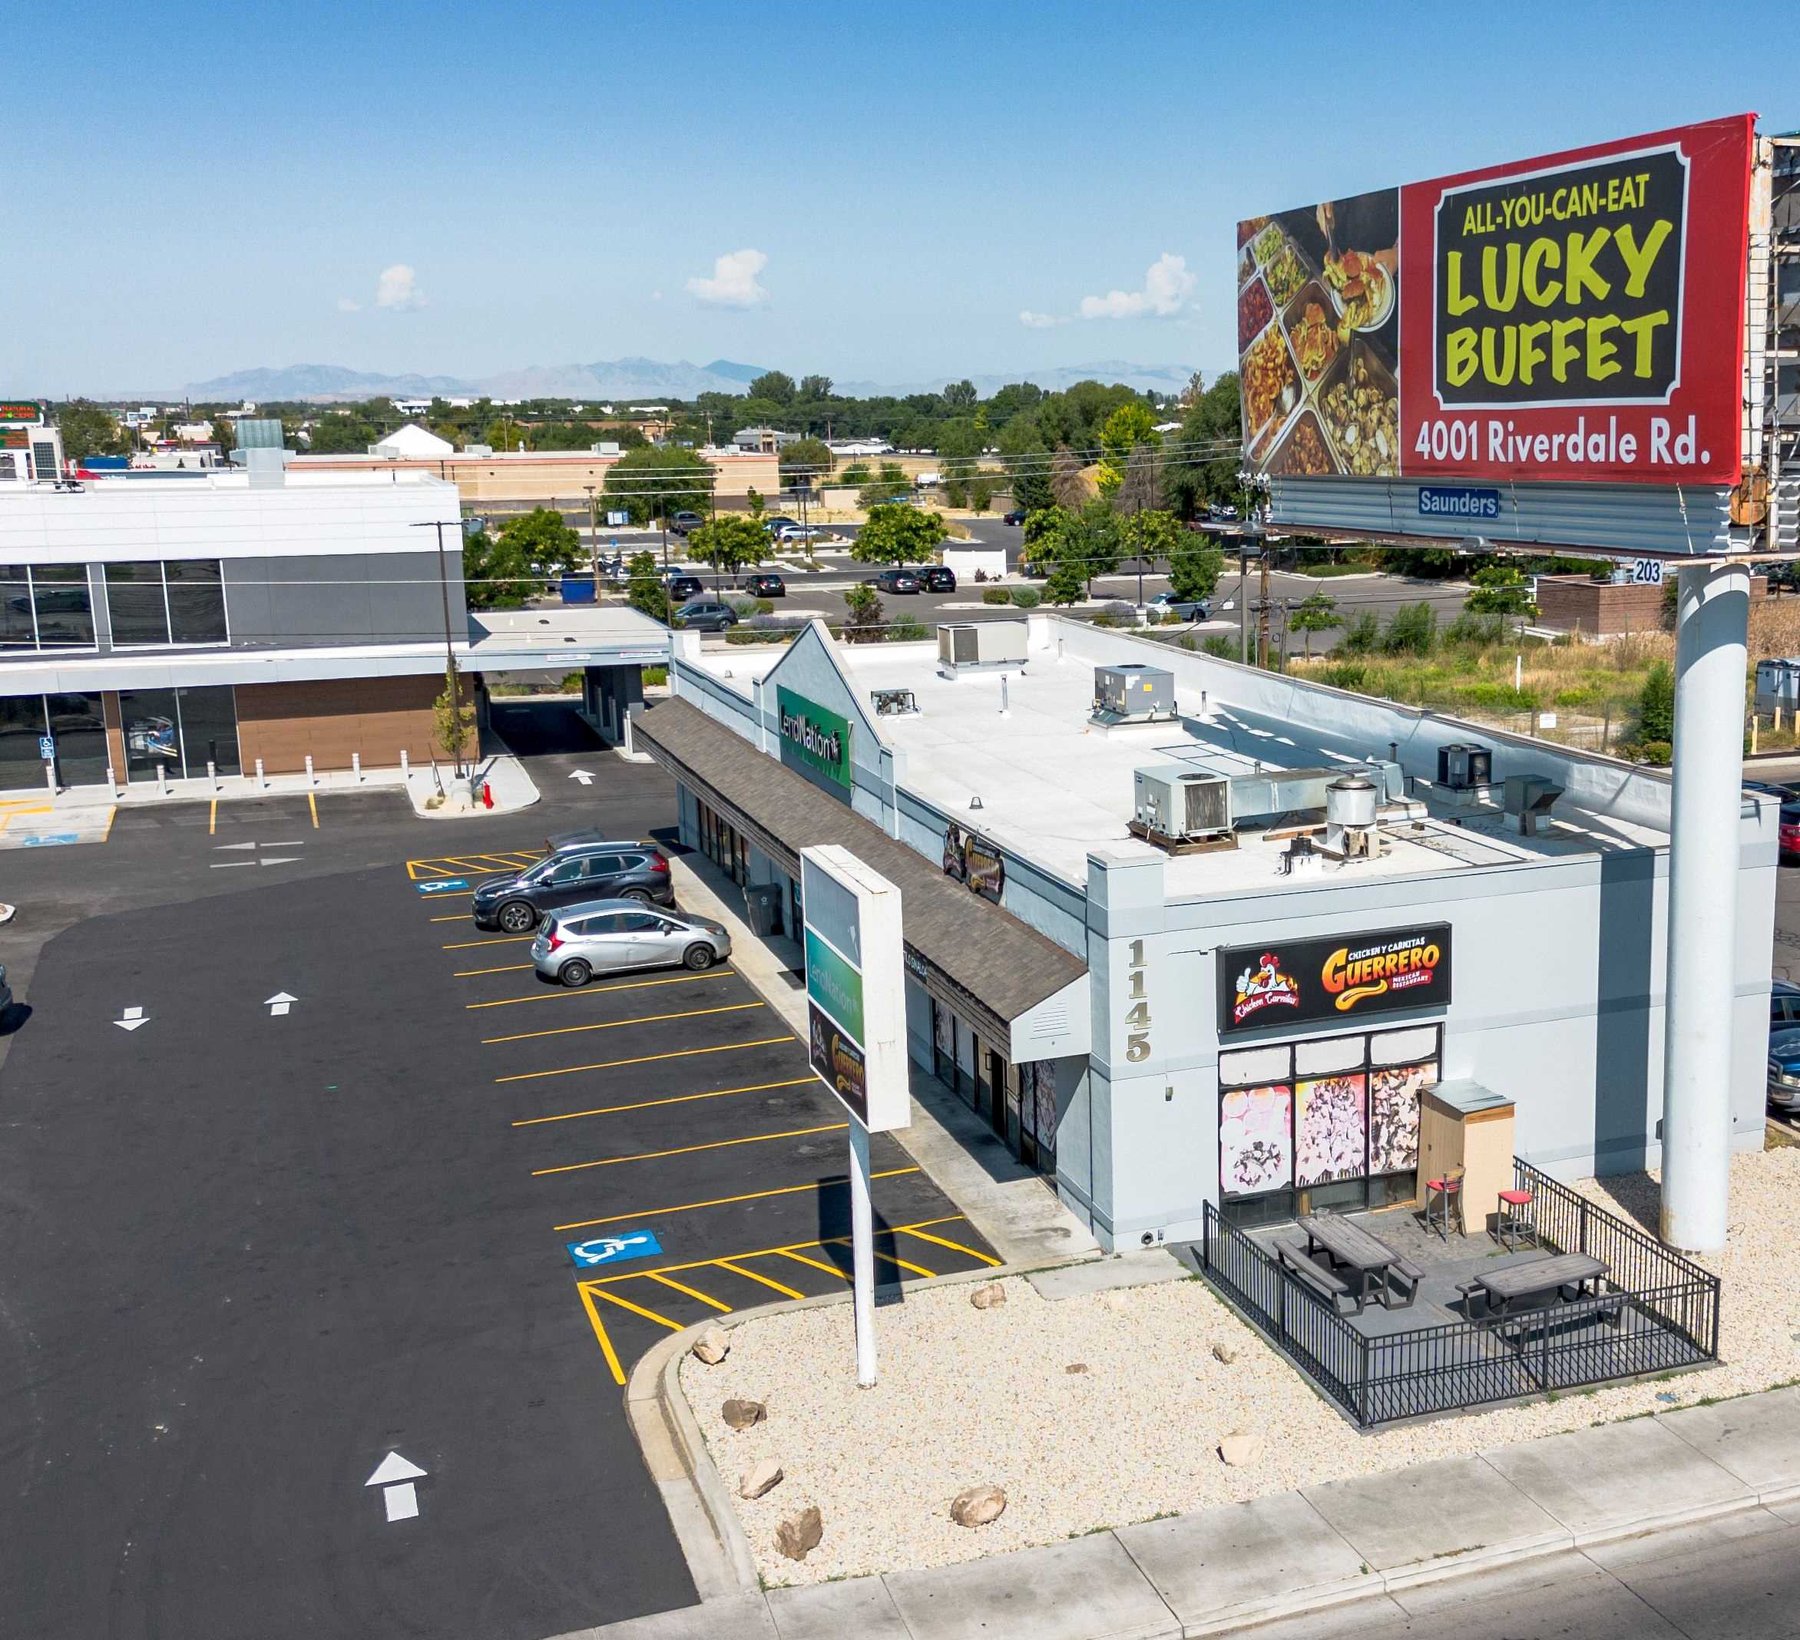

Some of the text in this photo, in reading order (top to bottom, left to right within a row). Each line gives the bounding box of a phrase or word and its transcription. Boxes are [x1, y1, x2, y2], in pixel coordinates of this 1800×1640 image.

[1462, 173, 1651, 237] ALL-YOU-CAN-EAT
[1446, 218, 1674, 317] LUCKY
[1446, 309, 1670, 388] BUFFET
[1413, 413, 1711, 465] 4001 Riverdale Rd.
[1420, 490, 1497, 515] Saunders
[1636, 560, 1661, 583] 203
[780, 704, 830, 760] LendNation
[1321, 944, 1441, 993] GUERRERO
[1348, 946, 1381, 961] CHICKEN
[1381, 945, 1387, 954] Y
[1124, 939, 1152, 1063] 1145
[1235, 998, 1264, 1018] Chicken
